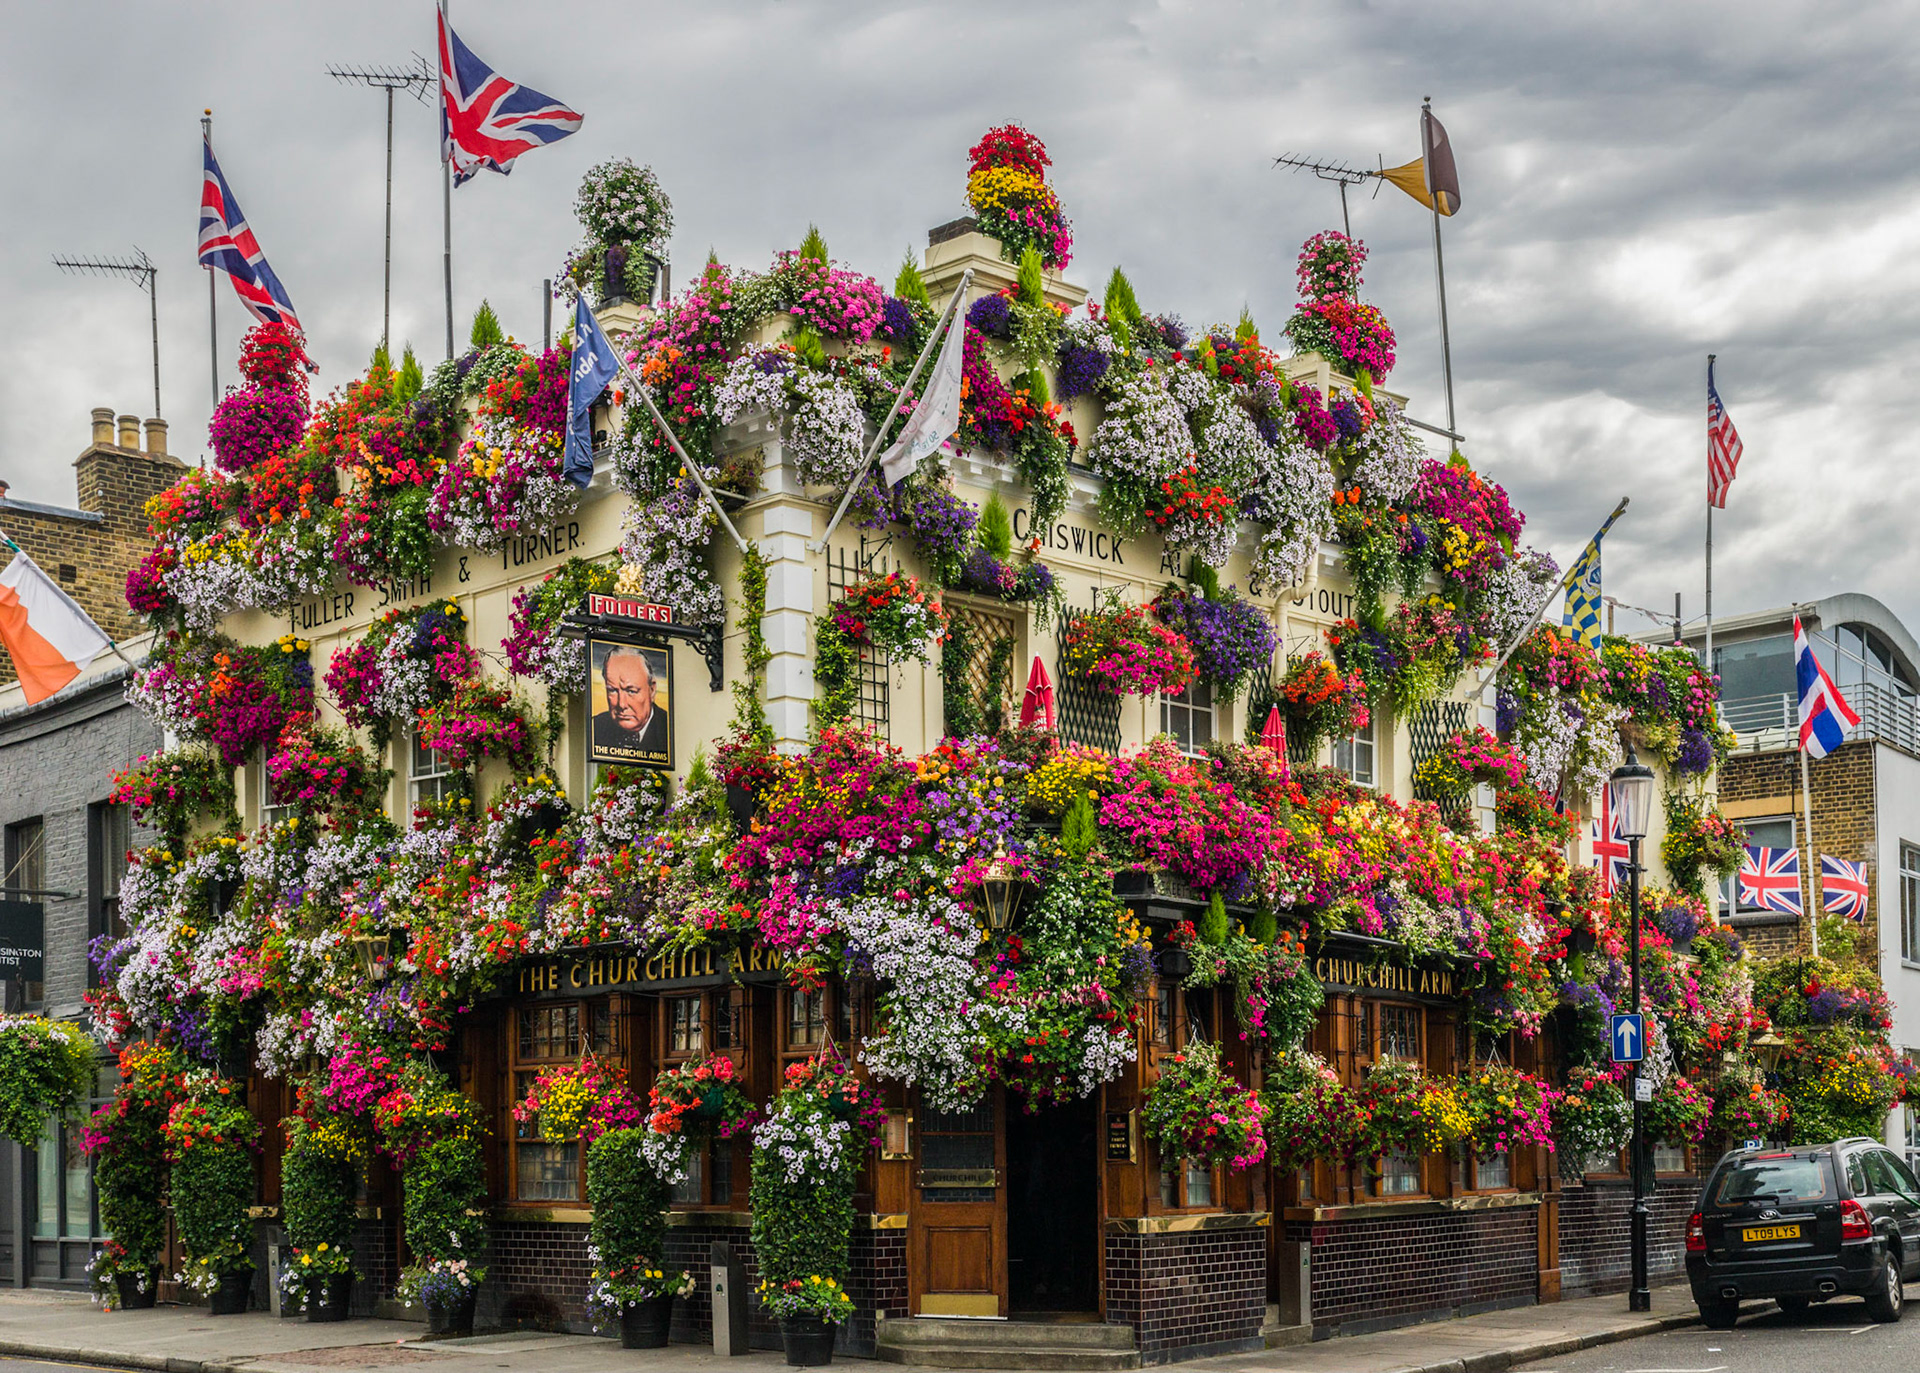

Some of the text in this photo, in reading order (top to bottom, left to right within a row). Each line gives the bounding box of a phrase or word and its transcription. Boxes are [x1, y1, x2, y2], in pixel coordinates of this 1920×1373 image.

[1013, 508, 1124, 564] CISWICK
[1160, 549, 1188, 579] AL
[290, 592, 354, 633] FULLER
[458, 556, 471, 583] &
[500, 521, 585, 570] TURNER.
[594, 596, 668, 622] FULLER'S
[595, 745, 668, 761] THE CHURCHILL ARMS
[0, 956, 20, 966] TIST
[570, 946, 715, 988] CHURCHILL
[729, 945, 782, 973] ARM
[1316, 957, 1453, 995] CHURCHILL ARM
[933, 1173, 982, 1182] CHURCHILL
[1746, 1226, 1796, 1240] LT09 LYS
